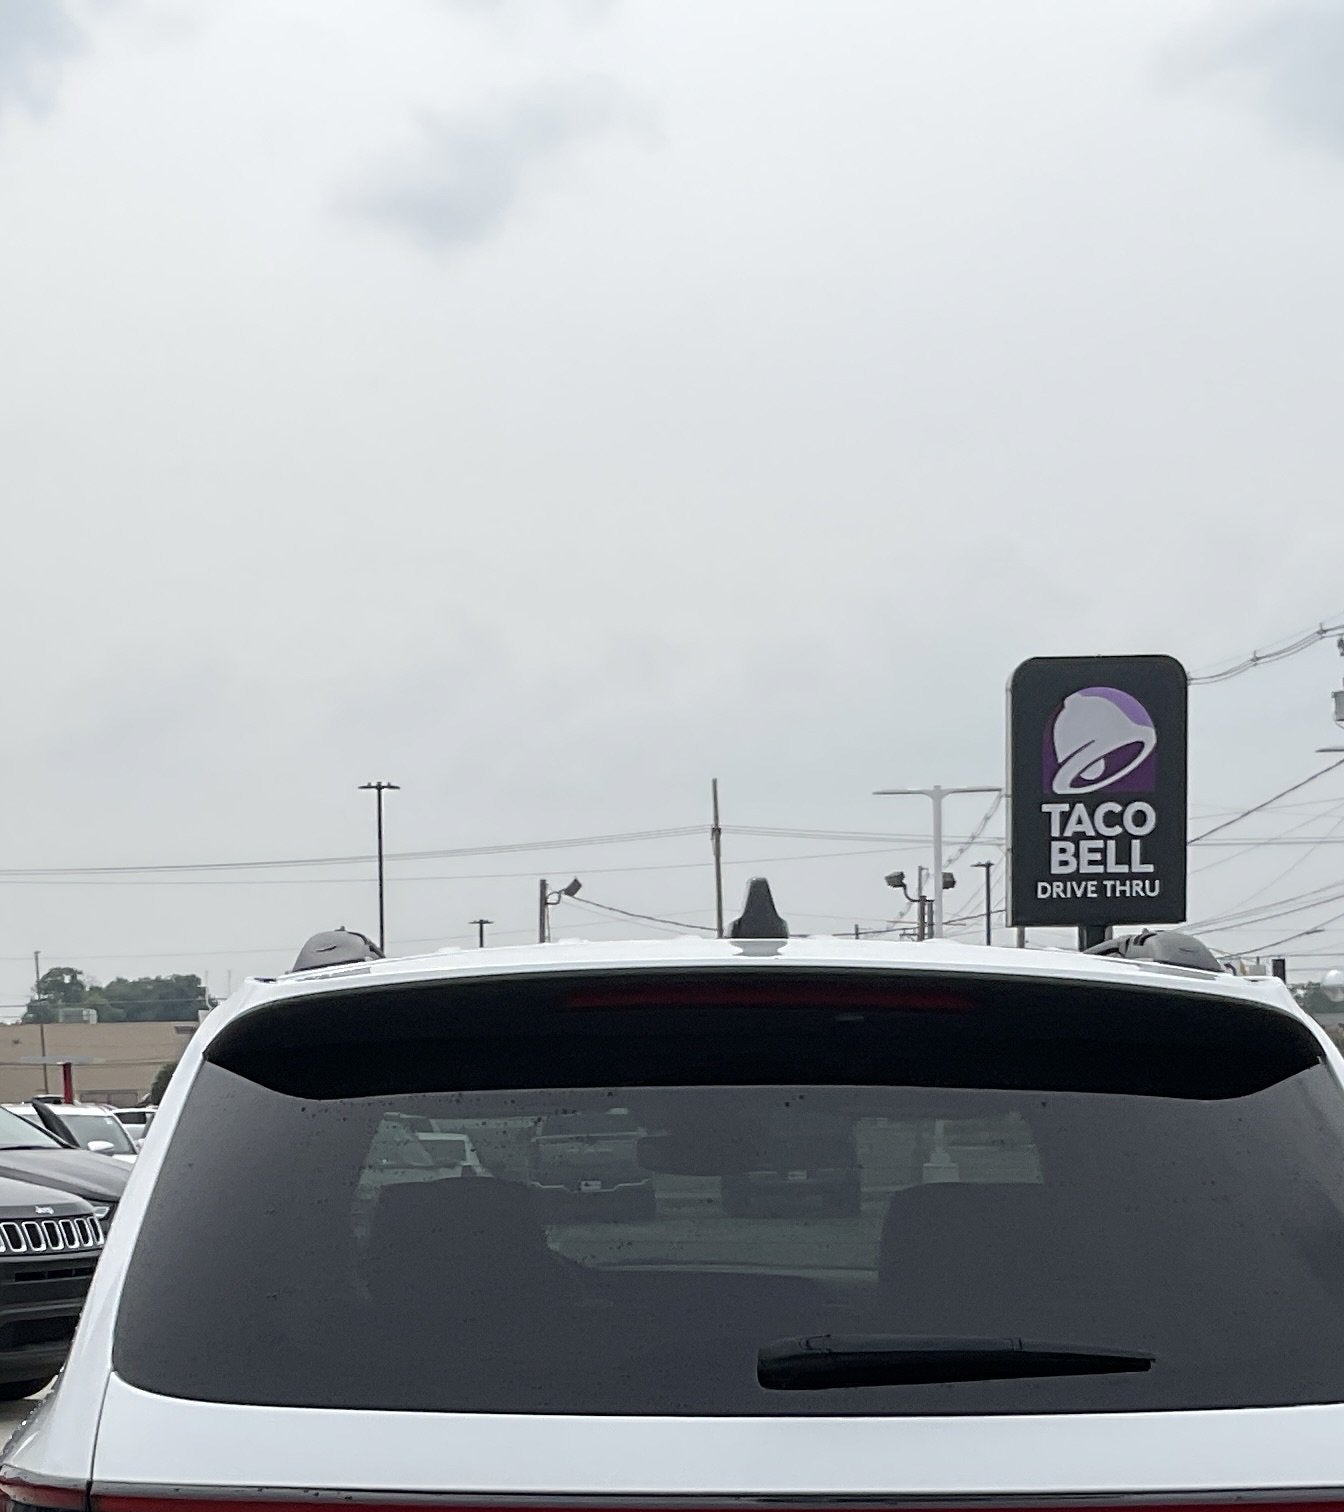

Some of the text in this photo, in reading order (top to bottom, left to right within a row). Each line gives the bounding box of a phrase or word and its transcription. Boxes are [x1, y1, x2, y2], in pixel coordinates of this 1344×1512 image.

[1041, 801, 1156, 837] TACO
[1050, 839, 1155, 874] BELL
[1037, 879, 1160, 899] DRIVE THRU
